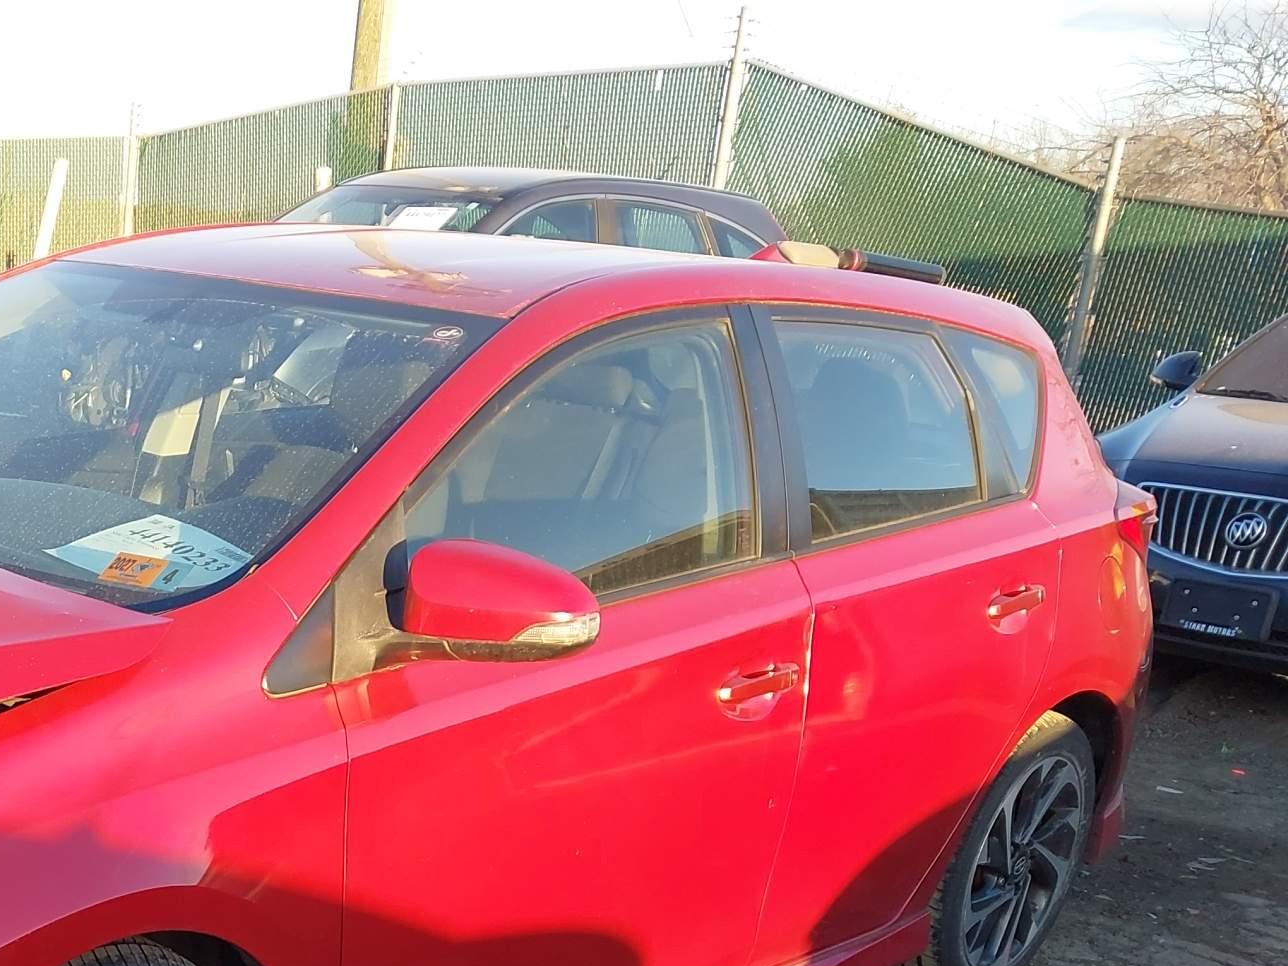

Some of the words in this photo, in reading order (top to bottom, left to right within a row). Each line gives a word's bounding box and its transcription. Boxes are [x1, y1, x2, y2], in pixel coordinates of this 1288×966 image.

[128, 528, 231, 571] 44140233
[107, 556, 138, 572] 2027
[161, 569, 180, 585] 4
